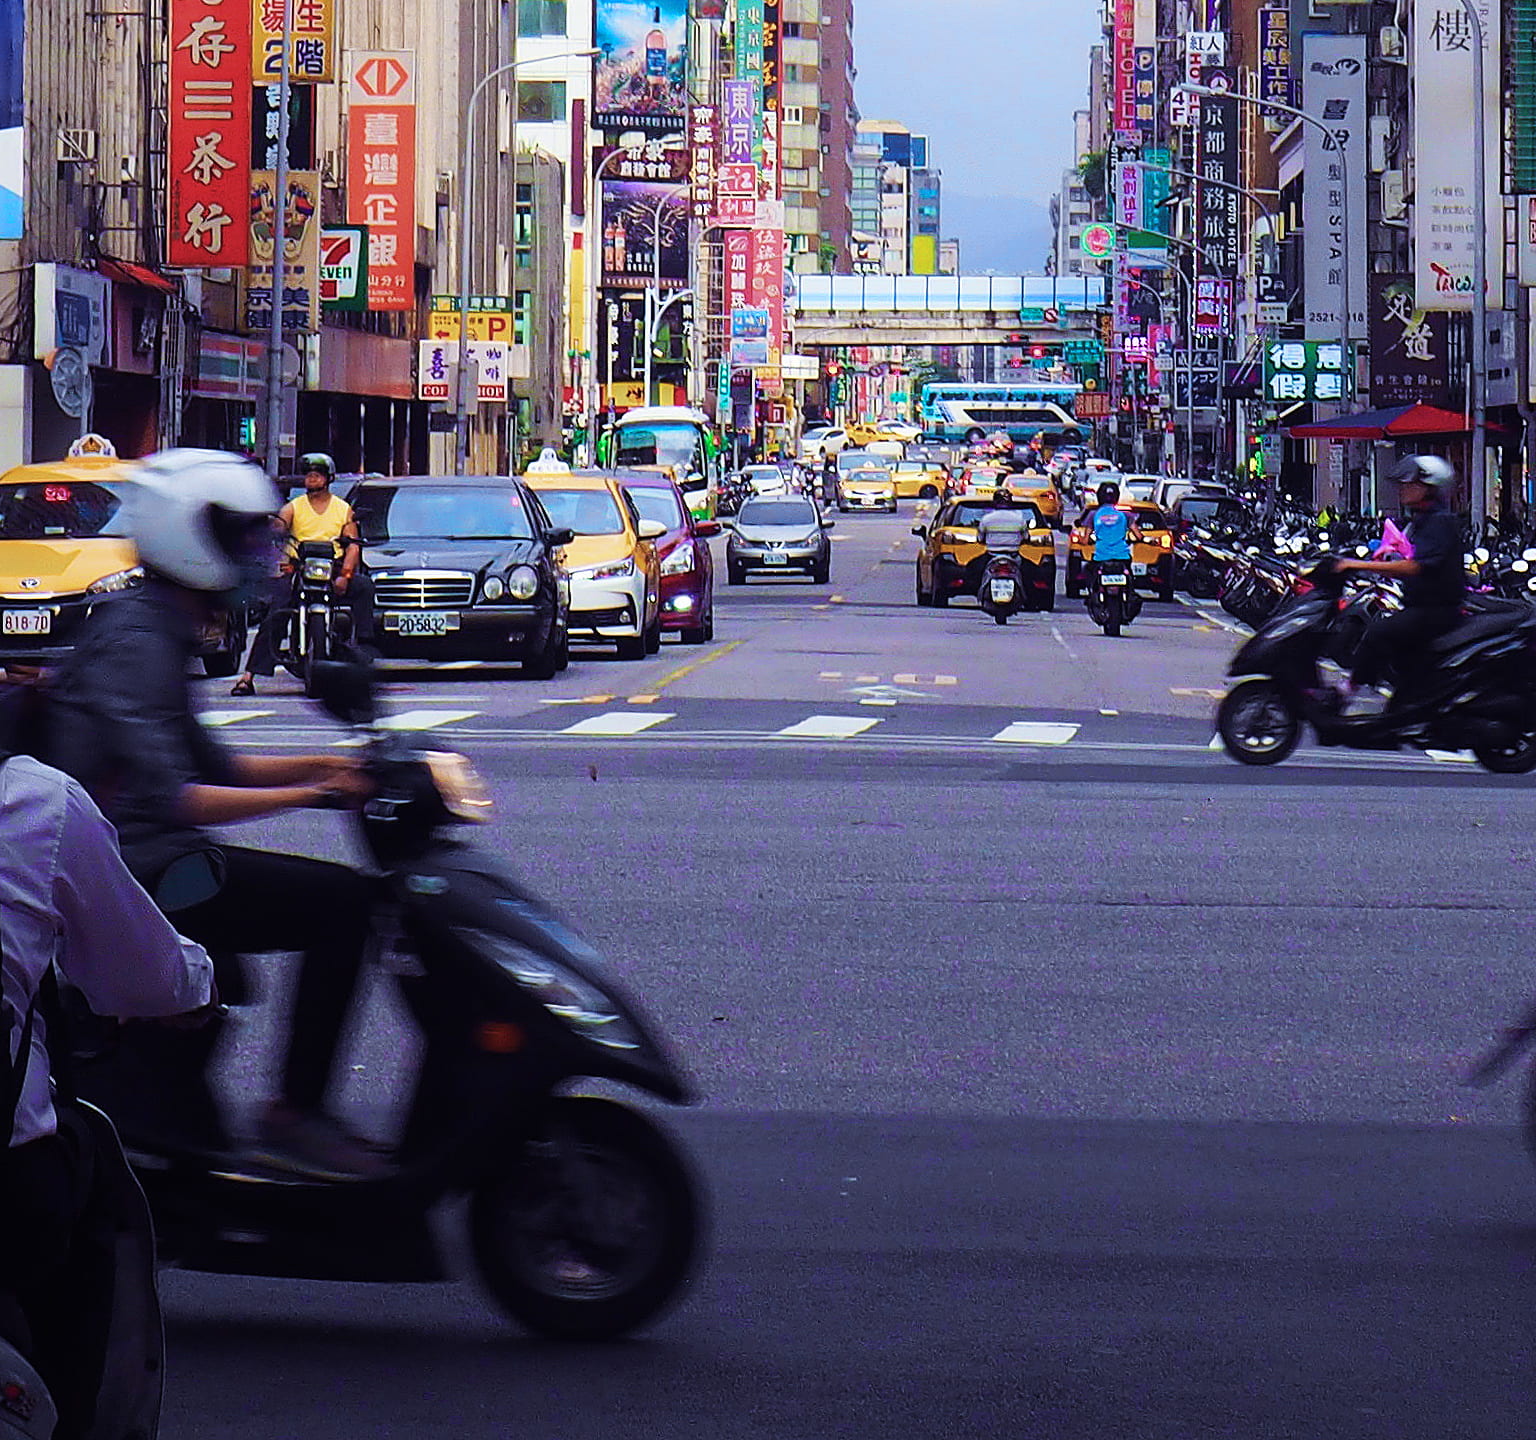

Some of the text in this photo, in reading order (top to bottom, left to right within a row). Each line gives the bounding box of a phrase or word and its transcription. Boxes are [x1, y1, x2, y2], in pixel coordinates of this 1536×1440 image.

[729, 84, 751, 155] 東京
[364, 113, 398, 266] 臺灣企銀
[1204, 104, 1225, 266] 京都商務旅館
[1227, 228, 1237, 268] HOTEL
[1259, 276, 1272, 296] P
[487, 317, 506, 341] P
